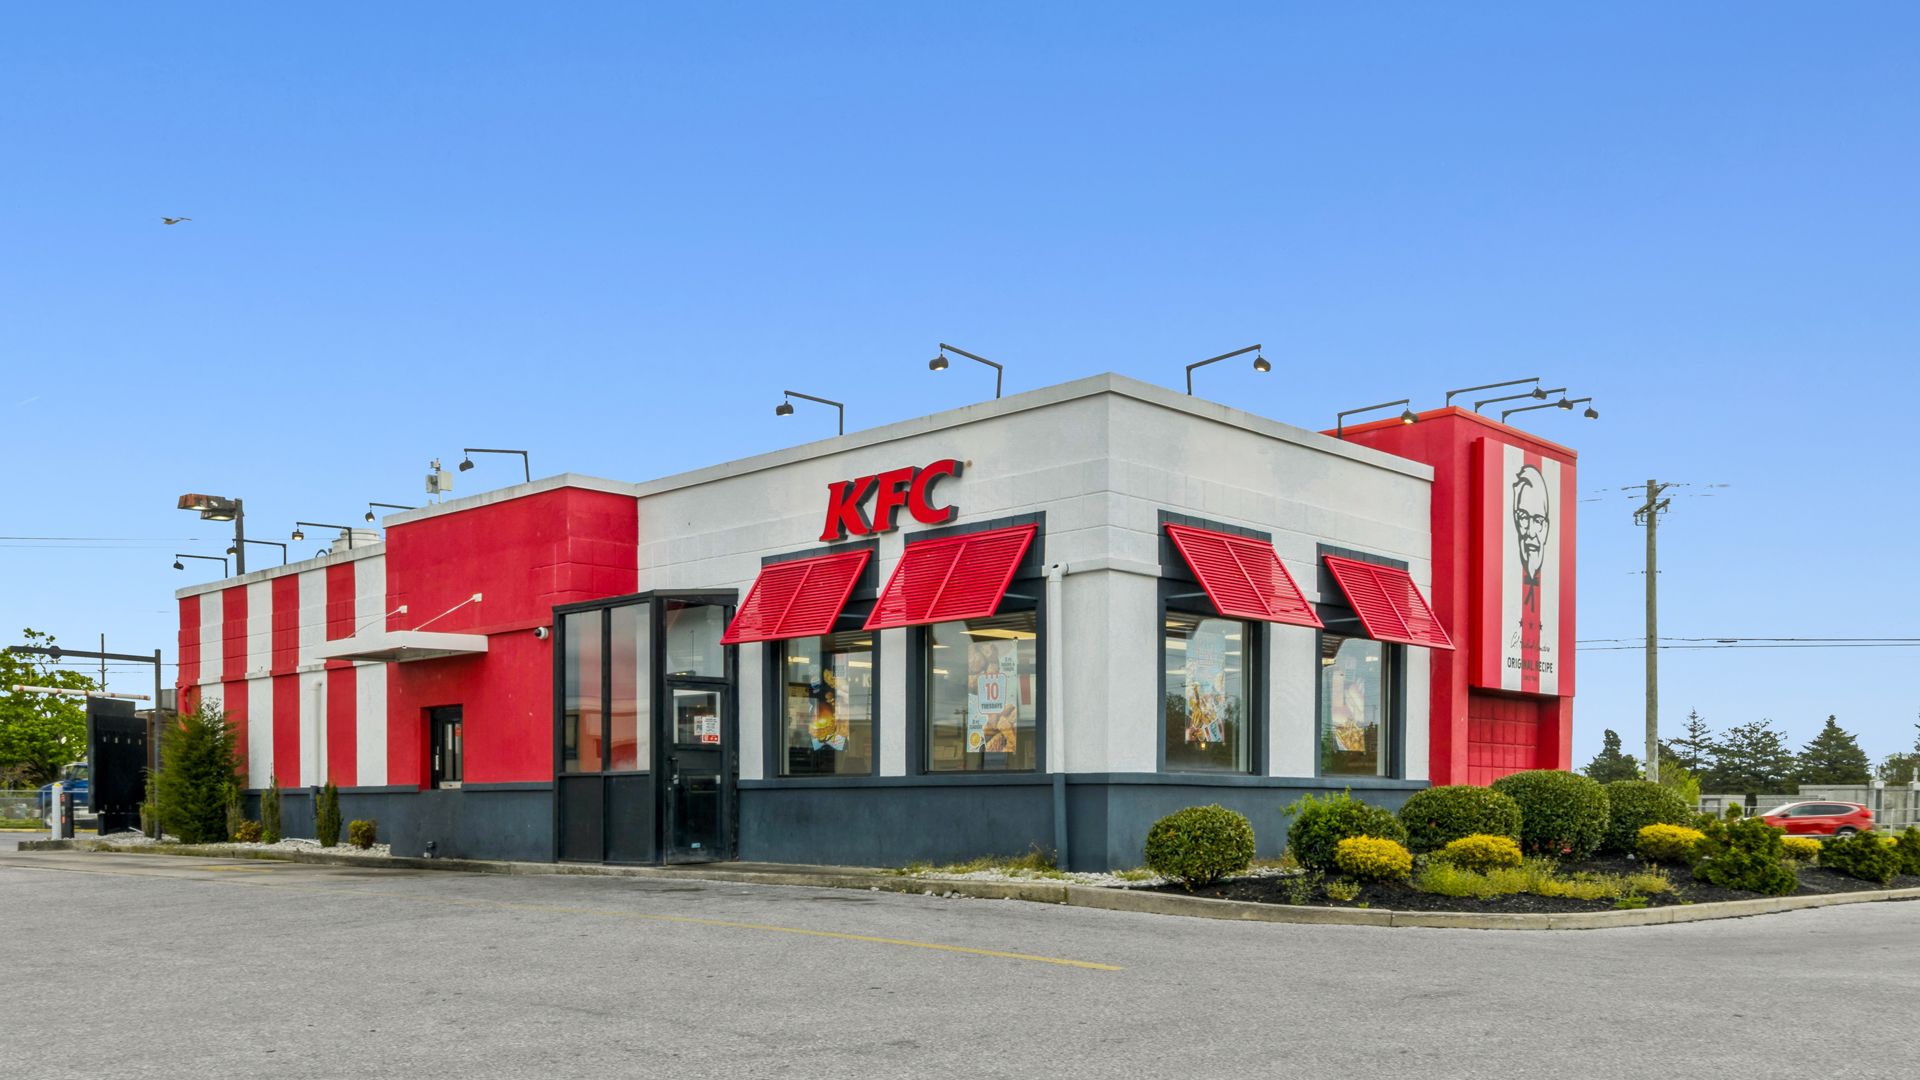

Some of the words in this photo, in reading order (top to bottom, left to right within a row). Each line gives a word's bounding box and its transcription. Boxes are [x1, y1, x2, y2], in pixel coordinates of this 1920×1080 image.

[819, 459, 964, 542] KFC
[1507, 657, 1534, 671] ORIGINAL
[1535, 661, 1553, 673] RECIPE
[985, 682, 999, 700] 10
